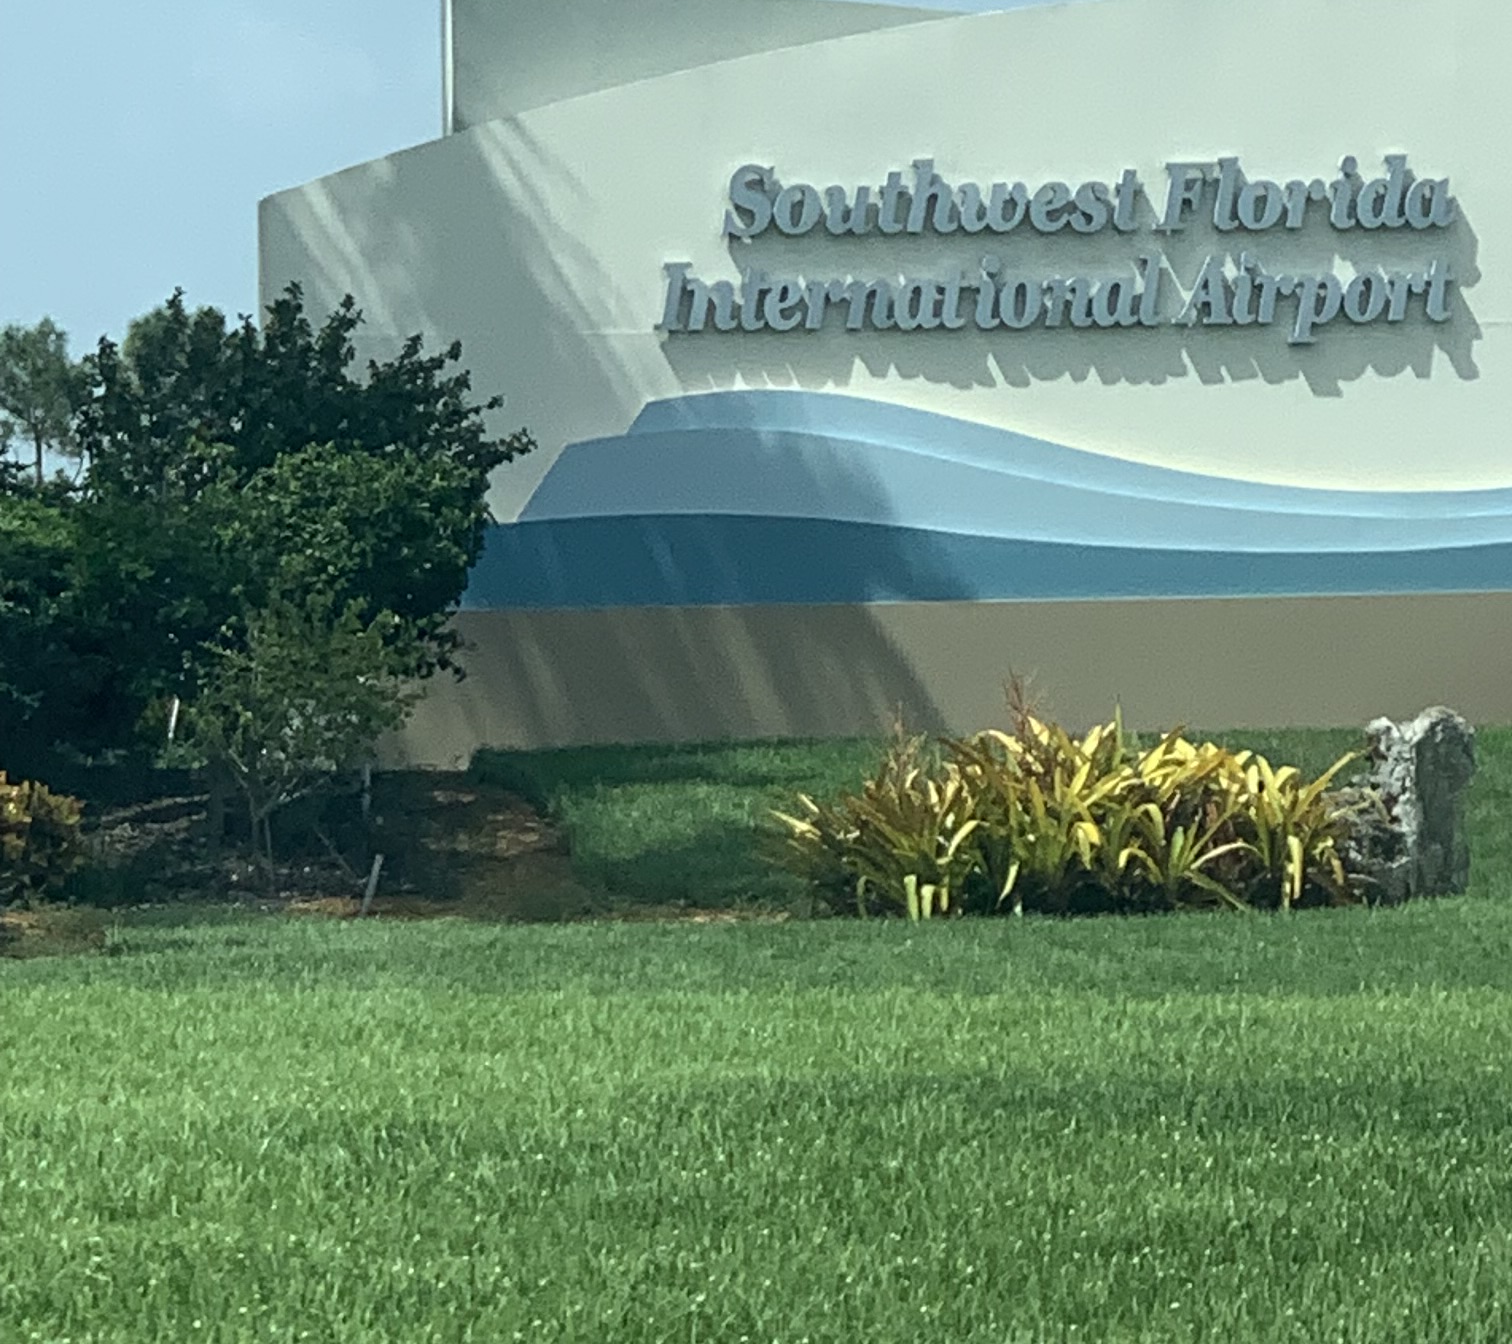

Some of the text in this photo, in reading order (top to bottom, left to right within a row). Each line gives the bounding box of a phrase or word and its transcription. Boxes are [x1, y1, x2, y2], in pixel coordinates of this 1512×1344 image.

[724, 154, 1457, 240] Southwest Florida
[655, 252, 1453, 344] International Airport
